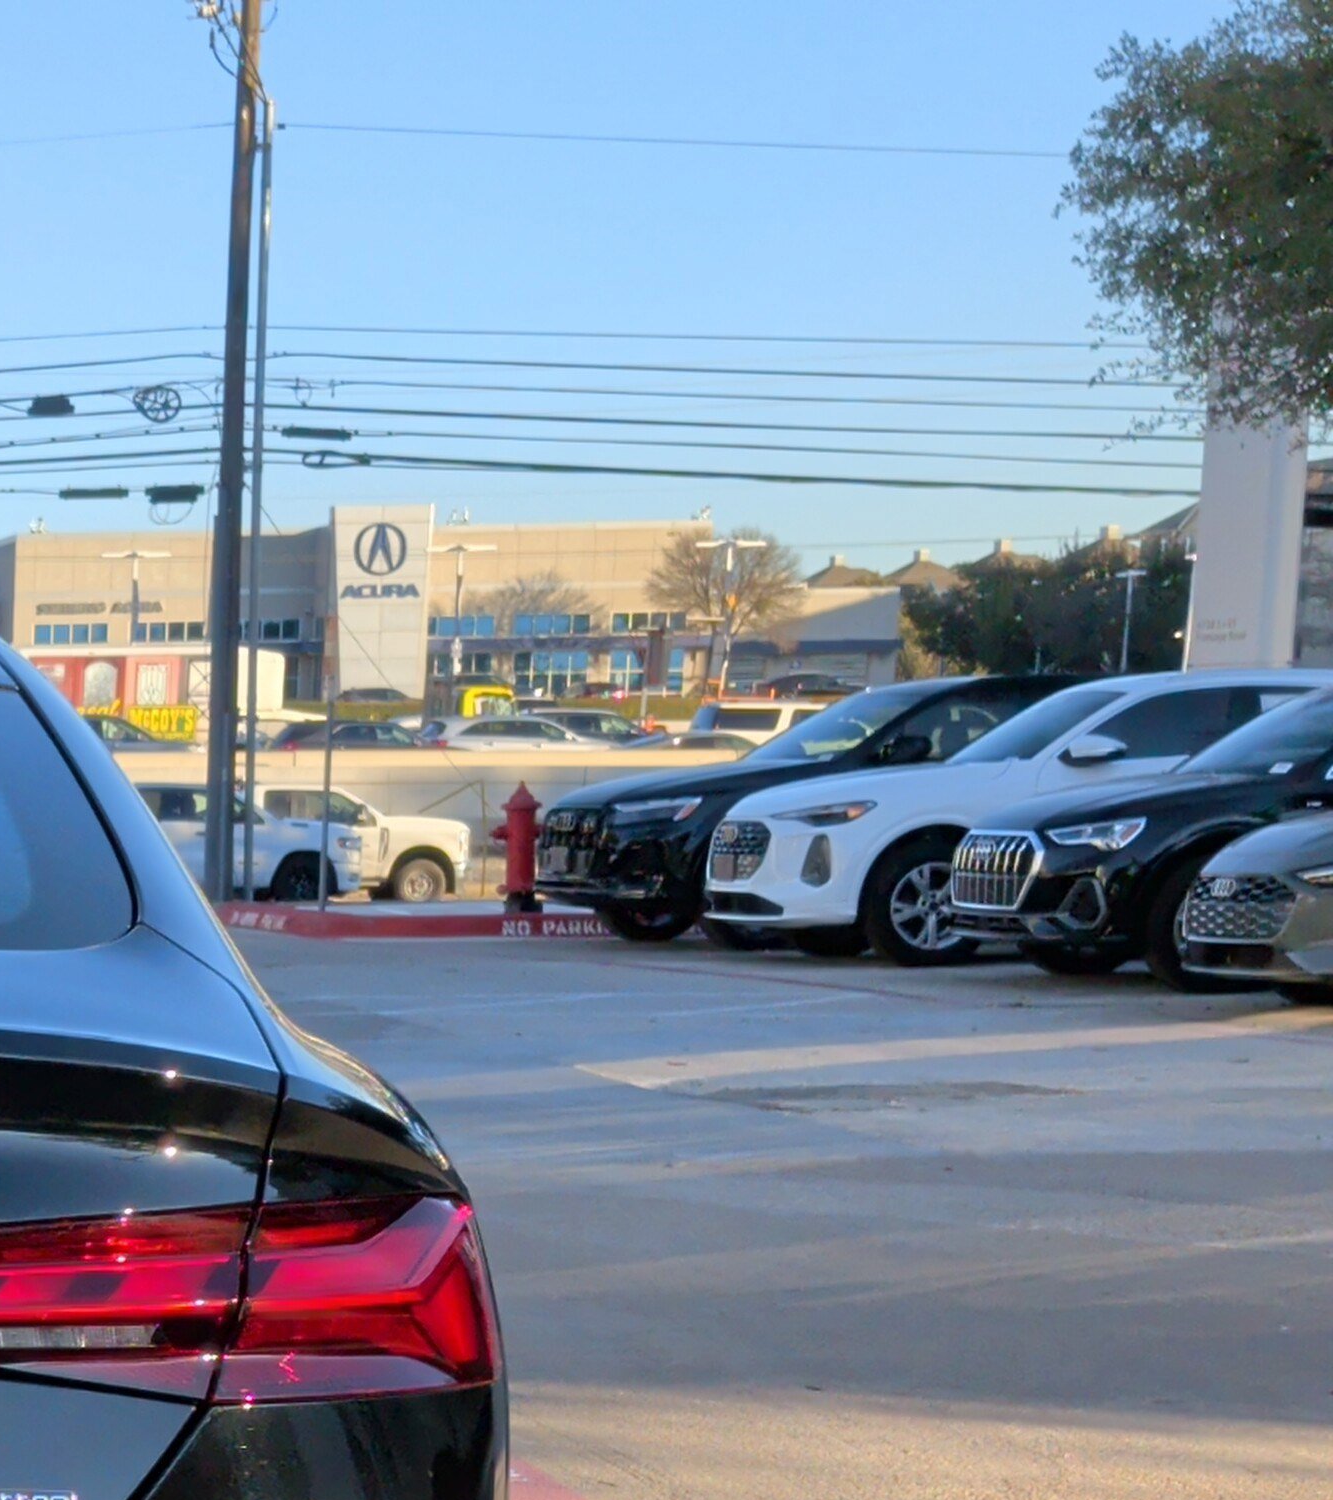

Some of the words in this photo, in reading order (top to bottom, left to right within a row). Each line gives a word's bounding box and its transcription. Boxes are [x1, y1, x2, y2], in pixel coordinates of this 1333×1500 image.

[340, 584, 420, 599] ACURA
[502, 921, 530, 936] NO
[542, 920, 610, 936] PARKI
